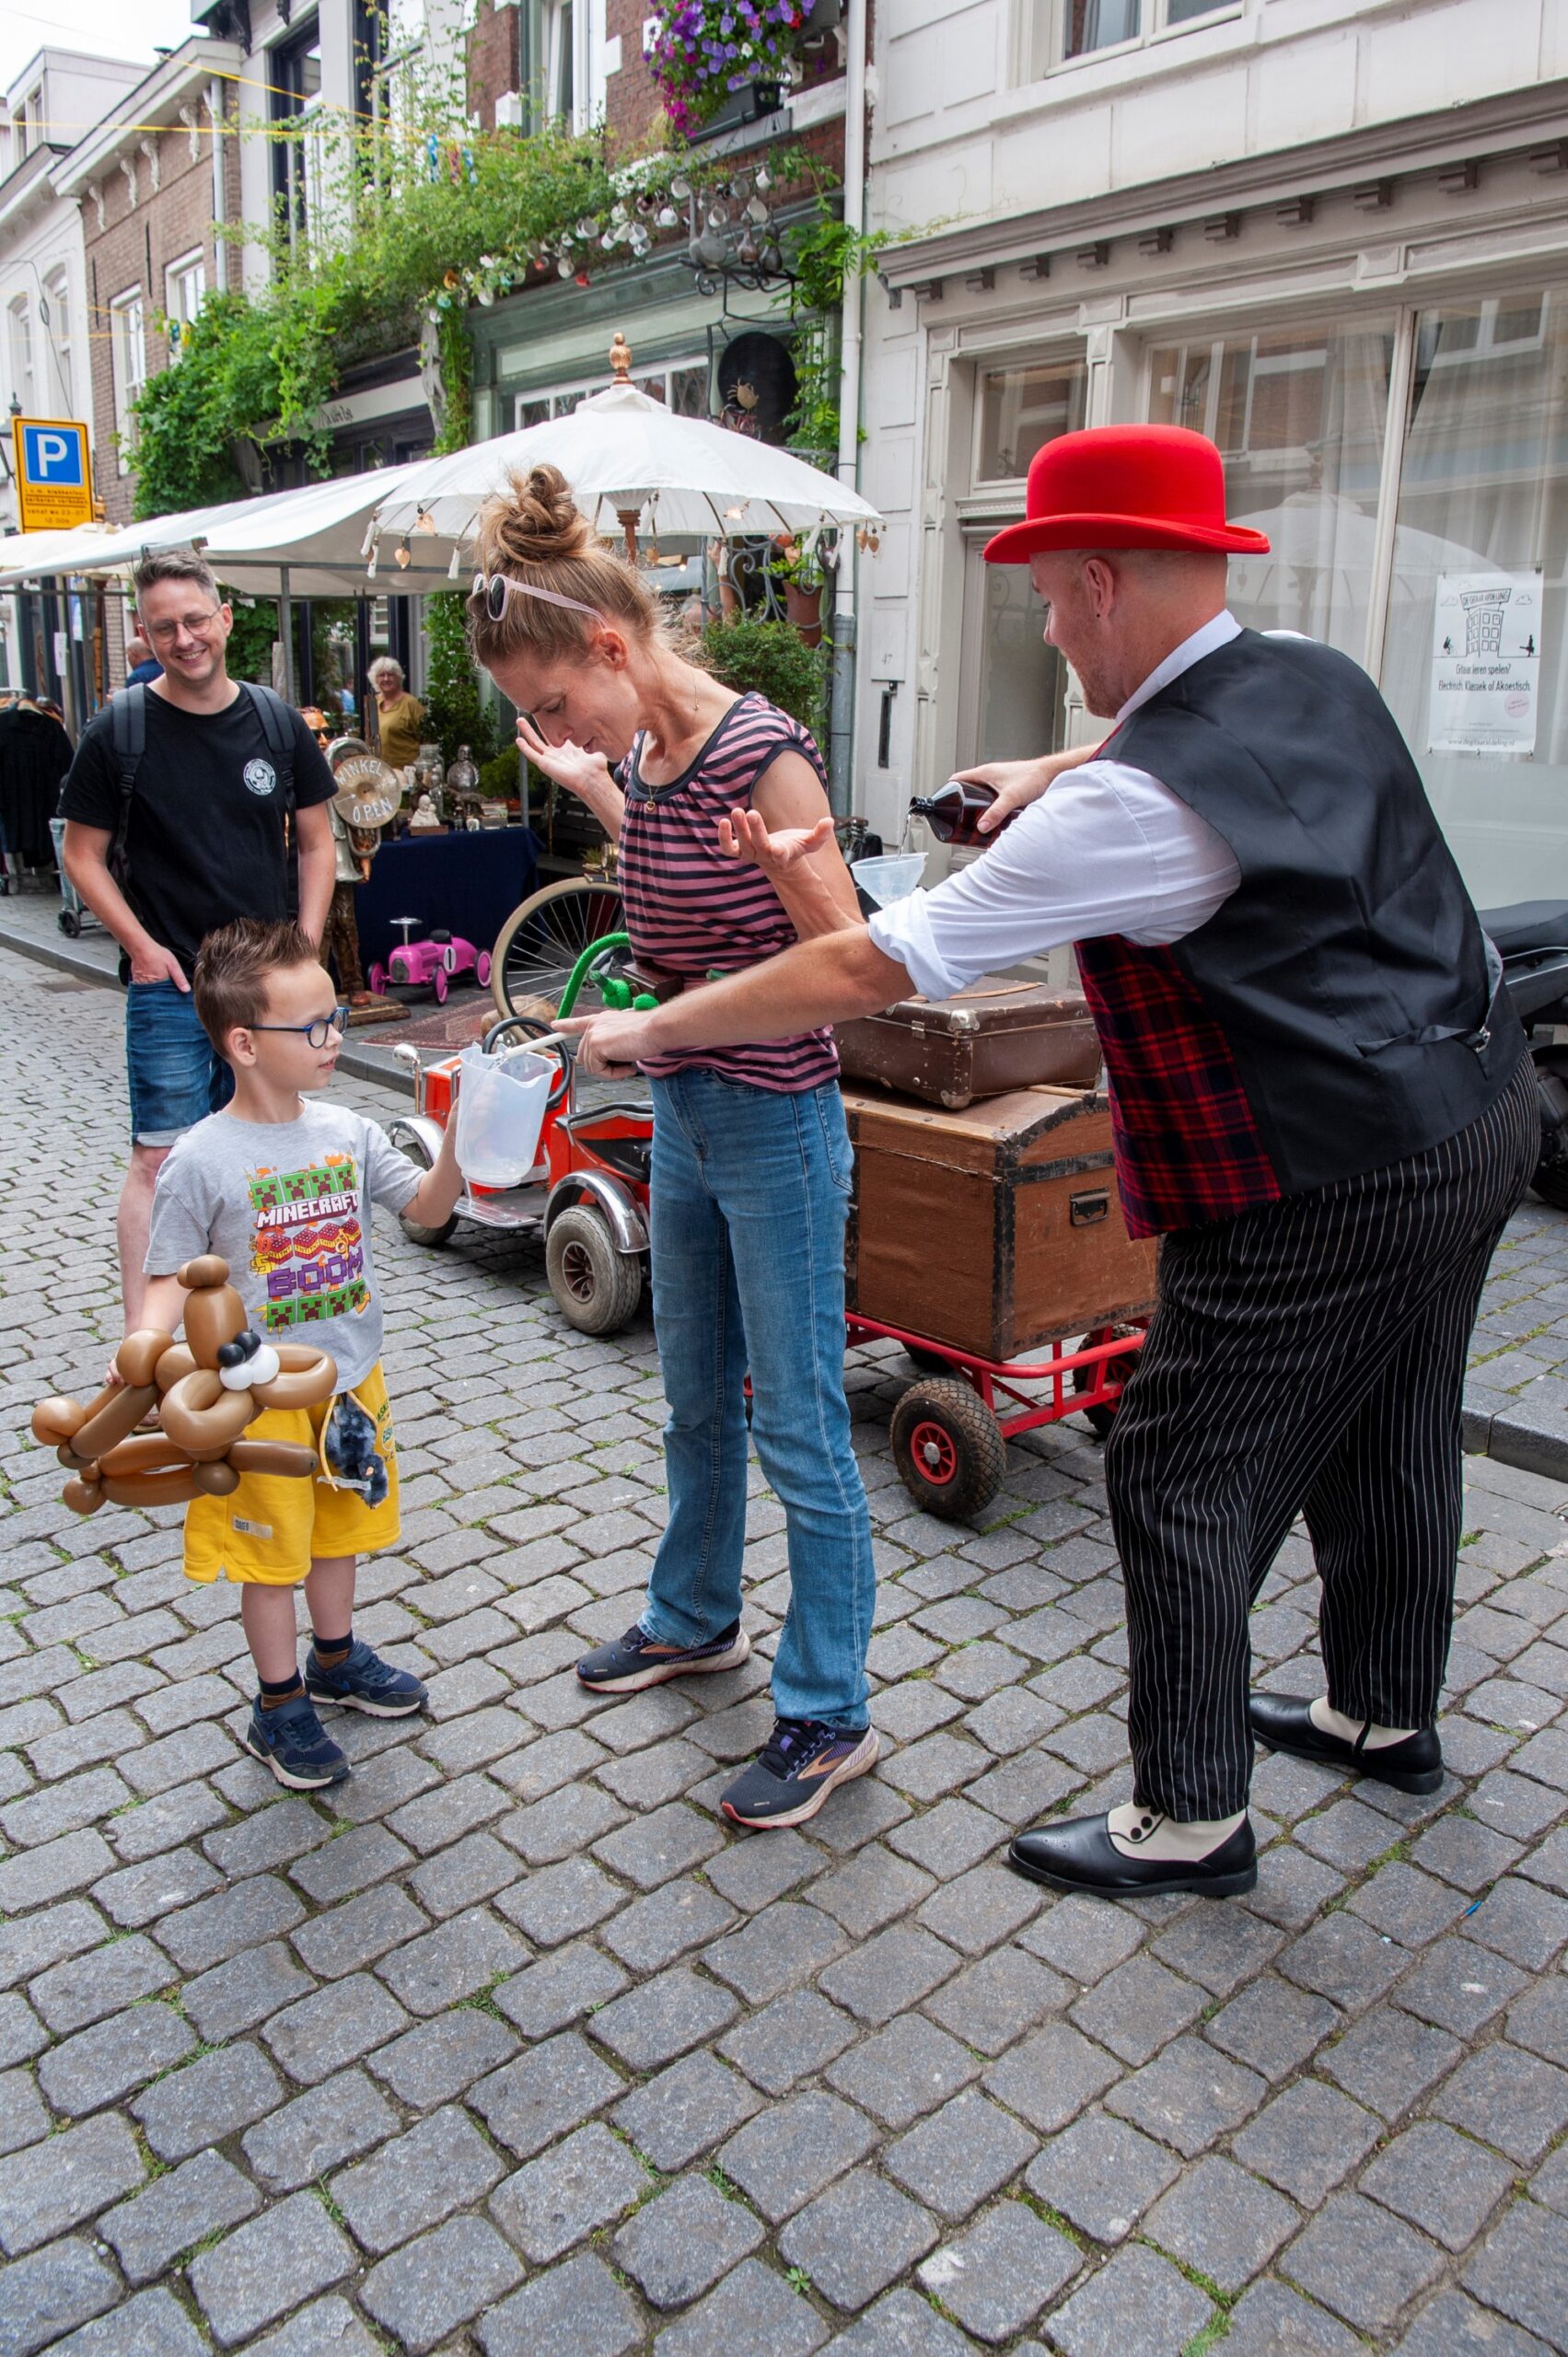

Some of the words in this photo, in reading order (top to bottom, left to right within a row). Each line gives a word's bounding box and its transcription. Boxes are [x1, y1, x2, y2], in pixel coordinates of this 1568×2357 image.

[37, 434, 67, 477] P
[881, 652, 893, 665] 47
[1456, 664, 1471, 674] Gitaar
[1472, 664, 1487, 674] leren
[1488, 663, 1512, 676] spelen?
[1465, 680, 1487, 691] Klassiek
[1488, 680, 1495, 691] of
[333, 760, 382, 785] WINKEL
[353, 796, 393, 824] OPEN
[257, 1192, 358, 1229] MINECRAFT
[267, 1246, 364, 1298] BOOM
